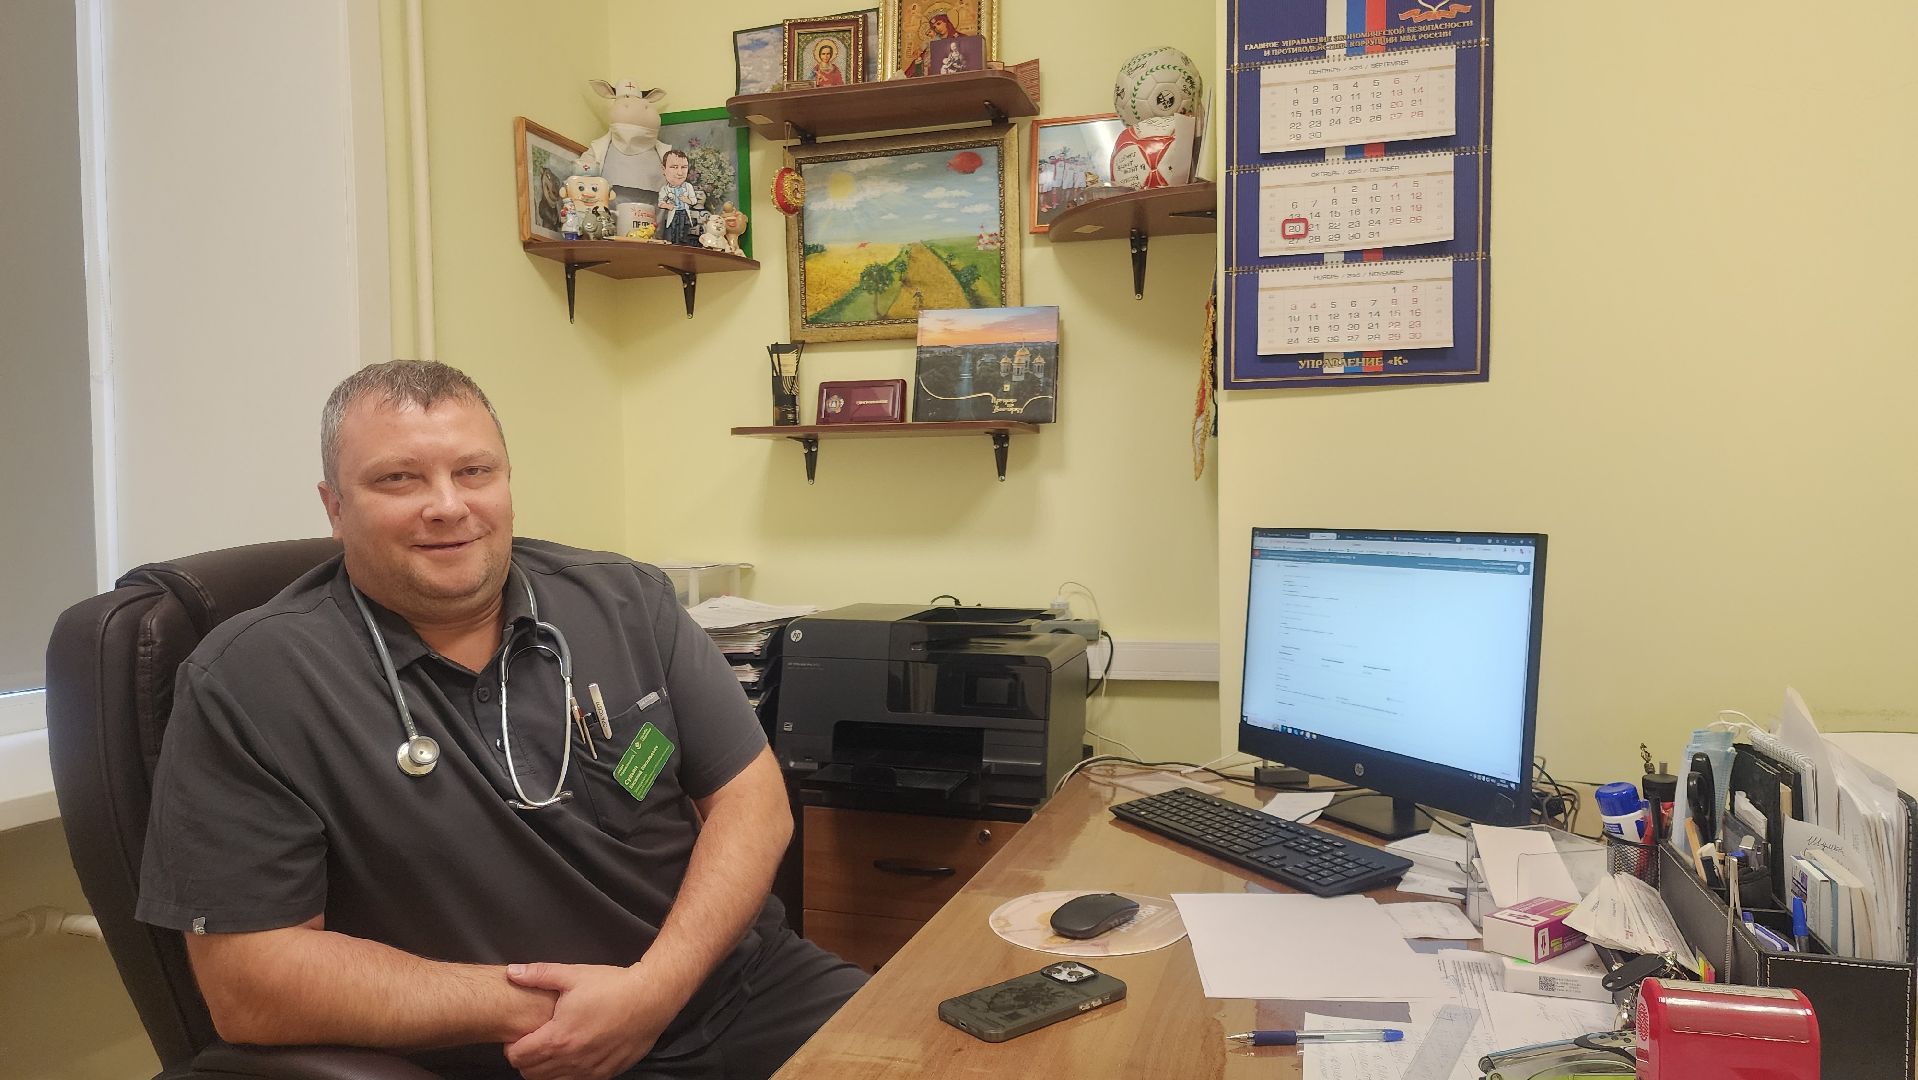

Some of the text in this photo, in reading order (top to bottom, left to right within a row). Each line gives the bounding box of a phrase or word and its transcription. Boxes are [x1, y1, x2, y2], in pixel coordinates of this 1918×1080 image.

[1245, 41, 1280, 51] ГЛАВНОЕ
[1281, 36, 1332, 48] УПРАВЛЕНИЕ
[1406, 20, 1474, 34] БЕЗОПАСНОСТИ
[1418, 30, 1452, 40] РОССИИ
[1298, 356, 1408, 370] УПРАВЛЕНИЕ «К»
